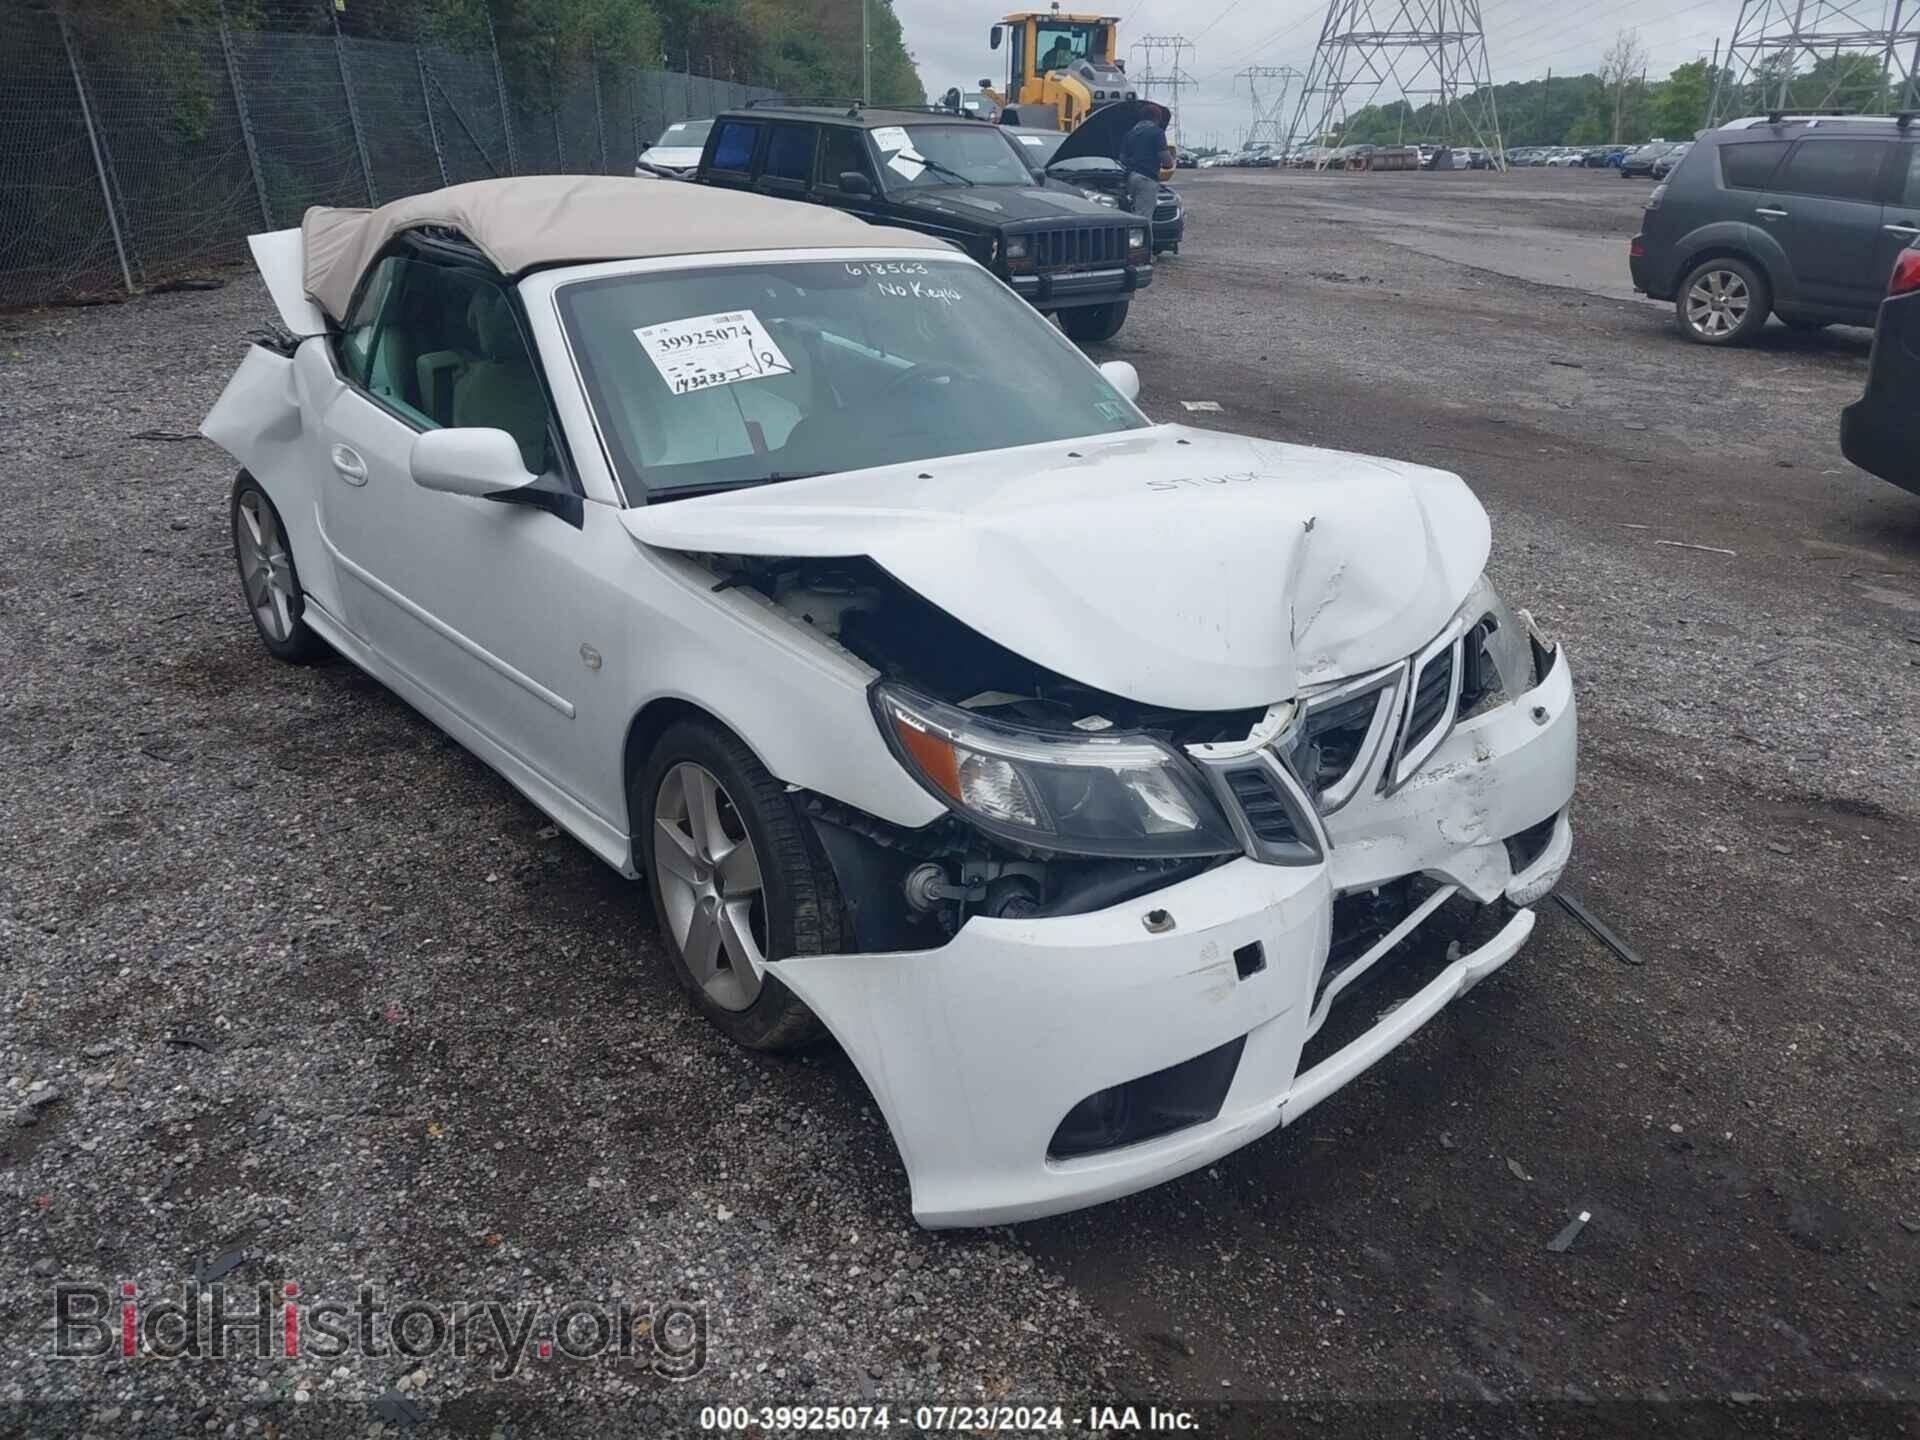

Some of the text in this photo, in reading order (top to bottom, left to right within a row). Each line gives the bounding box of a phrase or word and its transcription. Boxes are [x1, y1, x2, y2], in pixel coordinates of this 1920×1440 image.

[845, 262, 928, 276] 618563
[878, 282, 907, 296] No
[657, 325, 752, 352] 39925074
